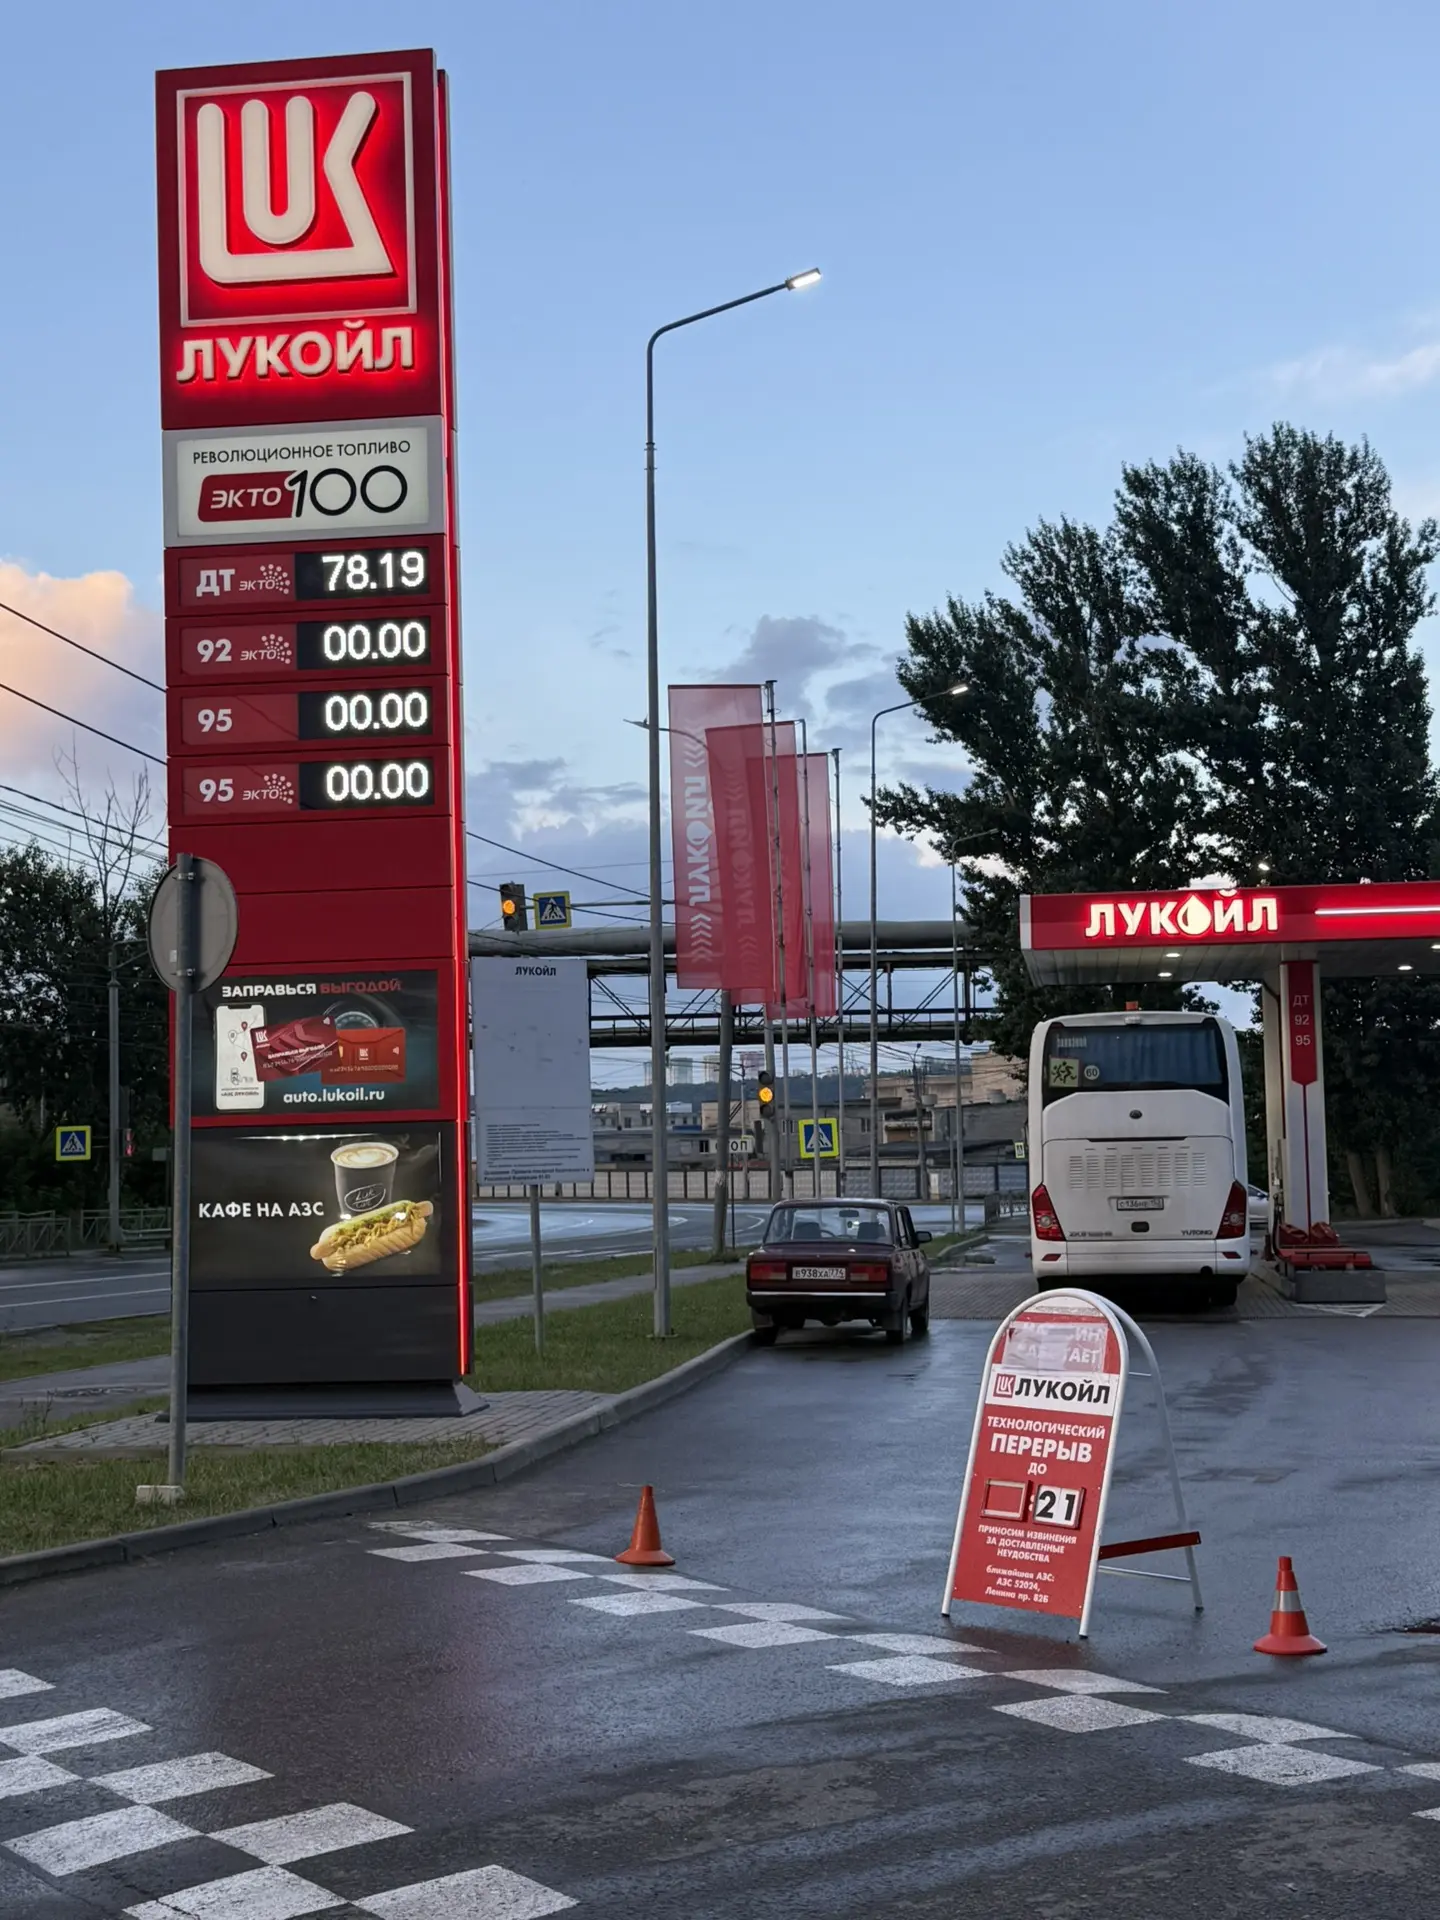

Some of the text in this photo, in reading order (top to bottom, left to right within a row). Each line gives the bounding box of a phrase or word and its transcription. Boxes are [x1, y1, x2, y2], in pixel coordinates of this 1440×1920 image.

[176, 320, 413, 381] ЛУКОЙЛ
[193, 440, 411, 464] РЕВОЛЮЦИОННОЕ ТОПЛИВО
[210, 465, 408, 518] ЭКТО 100
[196, 551, 425, 597] ДТ ЭКТО 78.19
[197, 622, 426, 662] 92 ЭКТО 00.00
[198, 692, 428, 732] 95 00.00
[200, 762, 429, 802] 95 ЭКТО 00.00
[1085, 889, 1278, 937] ЛУКОЙЛ
[515, 965, 556, 976] ЛУКОЙЛ
[222, 978, 402, 998] ЗАПРАВЬСЯ ВЫГОДОЙ
[1293, 995, 1309, 1007] ДТ
[1294, 1014, 1309, 1026] 92
[1295, 1035, 1310, 1046] 95
[1086, 1068, 1098, 1078] 60
[283, 1087, 385, 1104] auto.lukoil.ru
[199, 1201, 324, 1218] КАФЕ НА АЗС
[1015, 1378, 1110, 1404] ЛУКОЙЛ
[987, 1415, 1106, 1439] ТЕХНОЛОГИЧЕСКИЙ
[990, 1432, 1092, 1463] ПЕРЕРЫВ
[1027, 1462, 1047, 1475] ДО
[1036, 1490, 1076, 1521] 21
[978, 1524, 1077, 1544] ПРИНОСИМ ИЗВИНЕНИЯ
[986, 1536, 1064, 1554] ЗА ДОСТАВЛЕННЫЕ
[997, 1548, 1050, 1563] НЕУДОБСТВА
[996, 1577, 1012, 1587] АЗС
[1036, 1572, 1055, 1582] АЗС:
[985, 1586, 1016, 1598] Ленина
[1018, 1592, 1031, 1602] пр.
